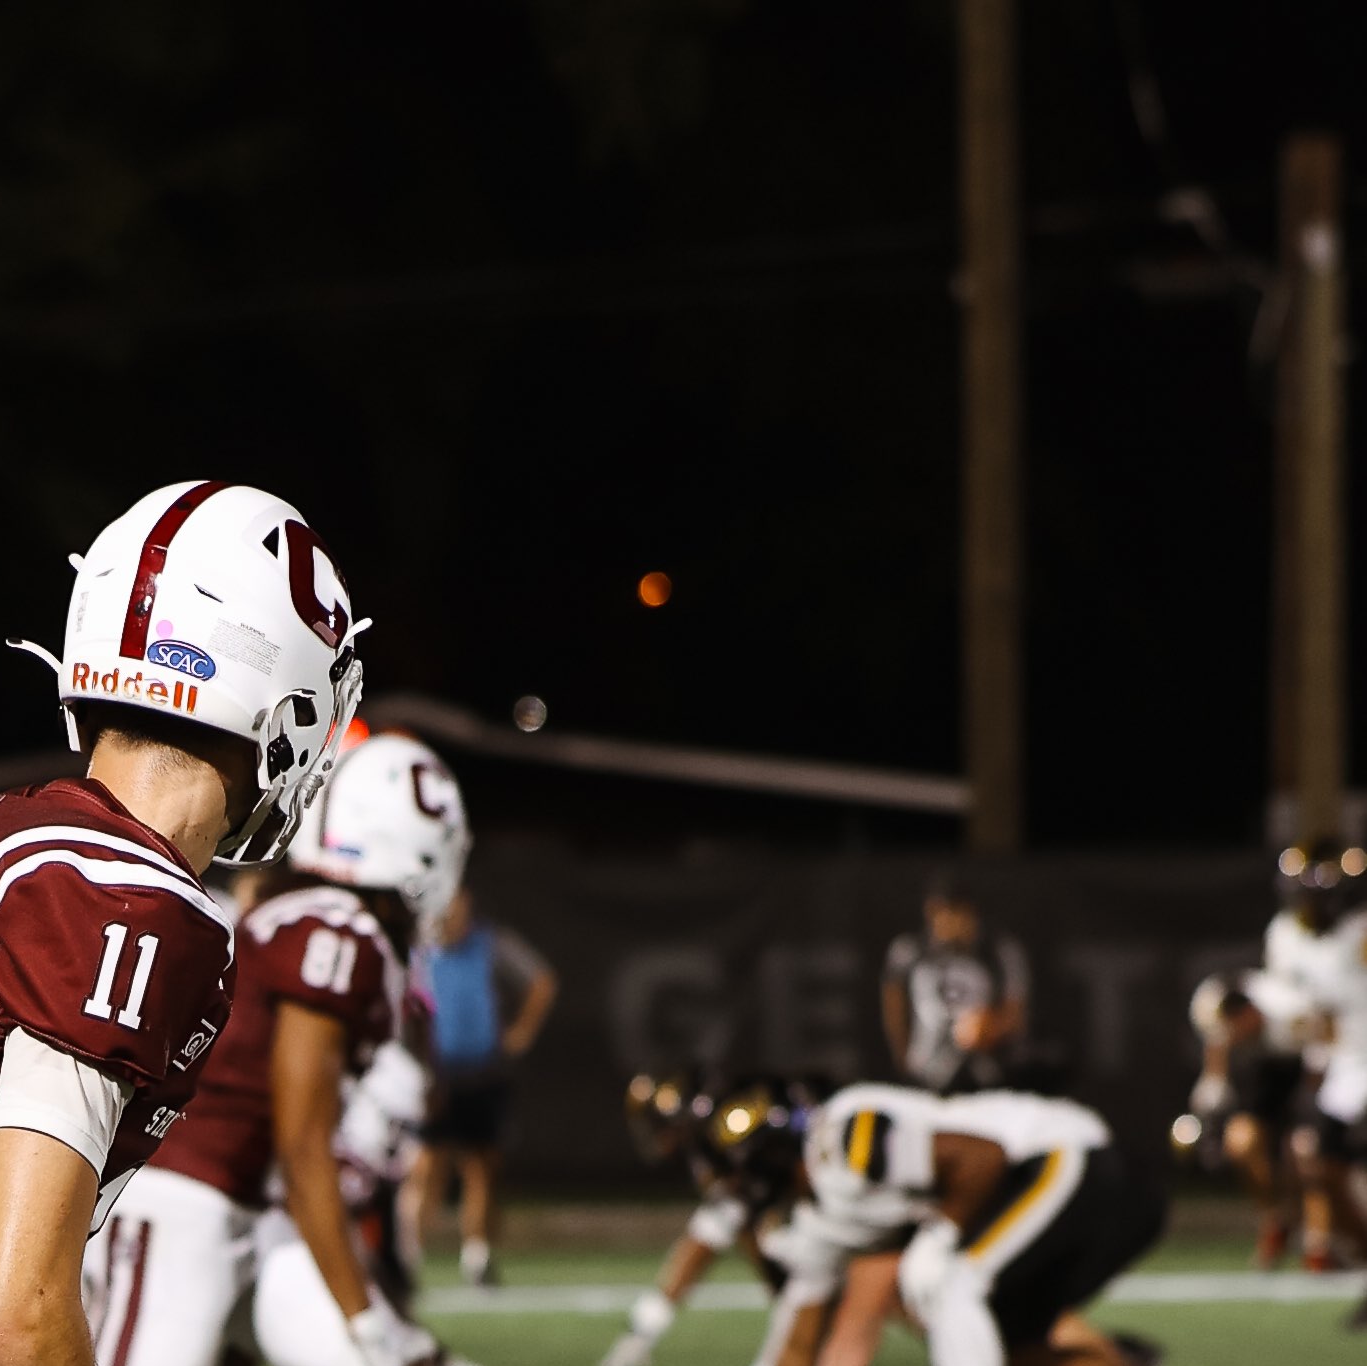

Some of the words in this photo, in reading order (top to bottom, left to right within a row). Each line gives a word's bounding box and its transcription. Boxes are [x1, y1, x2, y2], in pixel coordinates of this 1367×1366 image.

[156, 645, 208, 678] SCAC
[72, 662, 198, 715] Riddell
[84, 923, 159, 1030] 11
